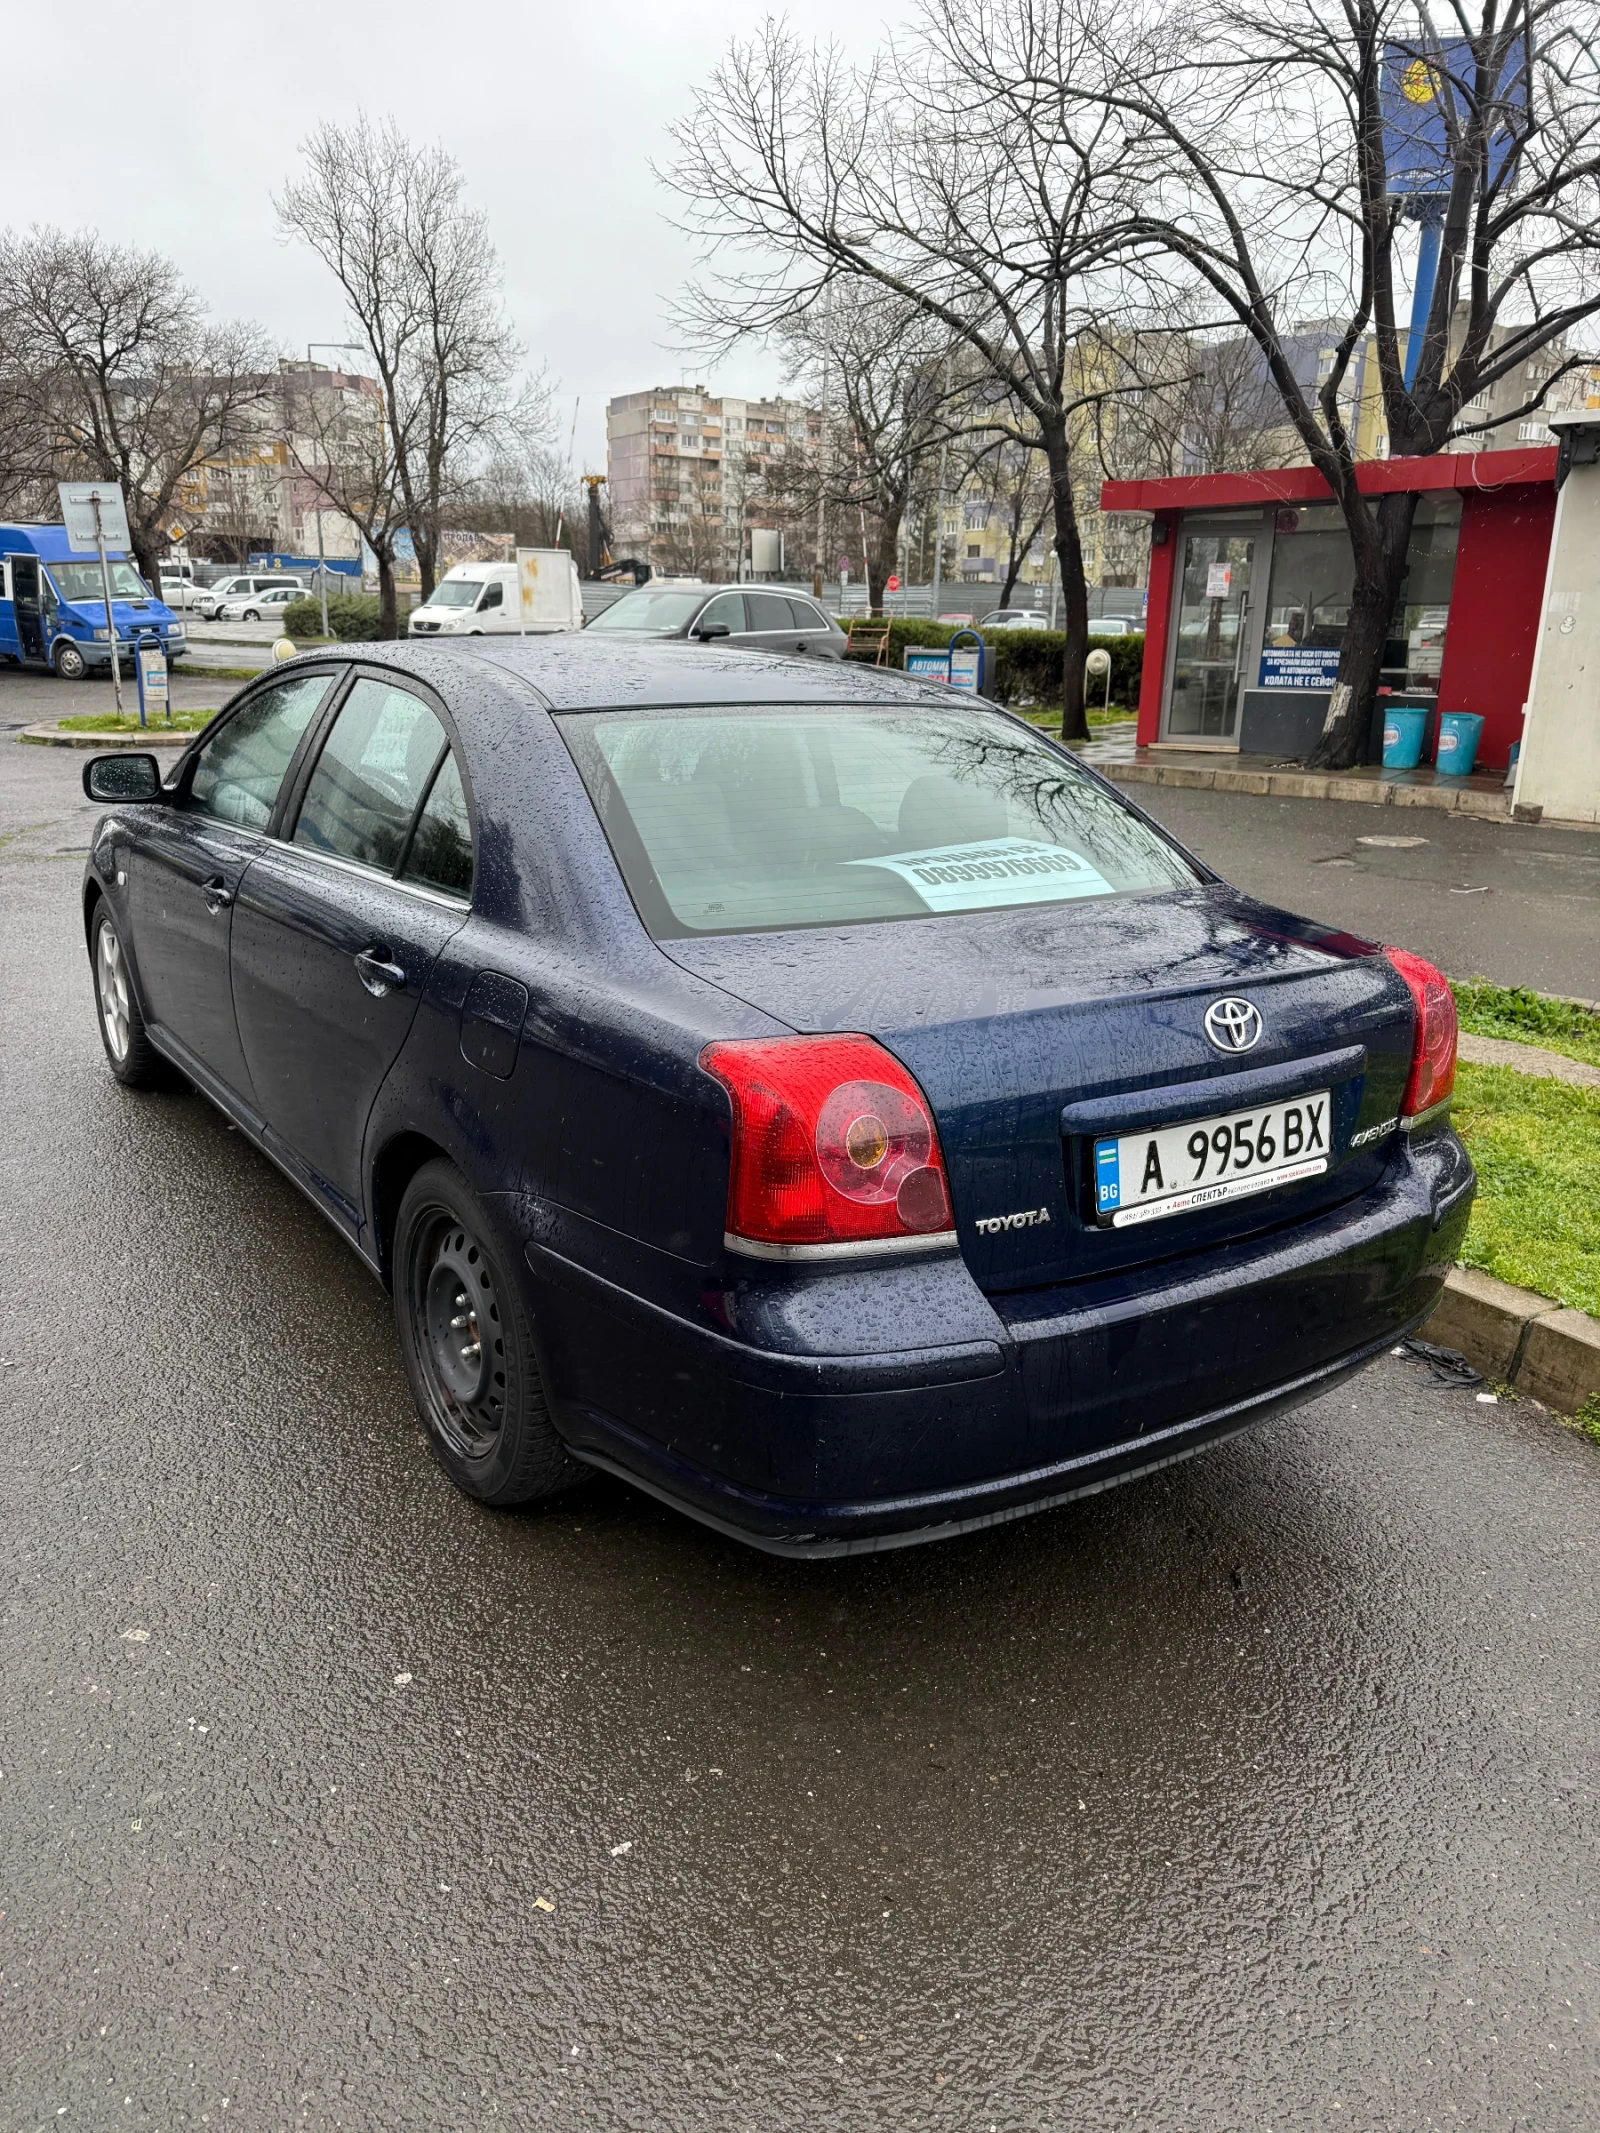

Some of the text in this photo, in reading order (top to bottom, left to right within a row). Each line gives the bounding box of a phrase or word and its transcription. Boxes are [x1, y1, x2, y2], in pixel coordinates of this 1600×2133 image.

[1301, 650, 1314, 658] НОСИ
[1264, 675, 1293, 685] КОЛАТА
[1294, 676, 1304, 686] НЕ
[1304, 676, 1310, 686] Е
[911, 854, 1082, 885] 0899976669
[1140, 1100, 1325, 1193] A 9956 BX
[1100, 1183, 1118, 1201] BG
[1172, 1199, 1190, 1209] Авто
[1191, 1187, 1228, 1204] СПЕКТЪР
[975, 1207, 1051, 1235] TOYOTA
